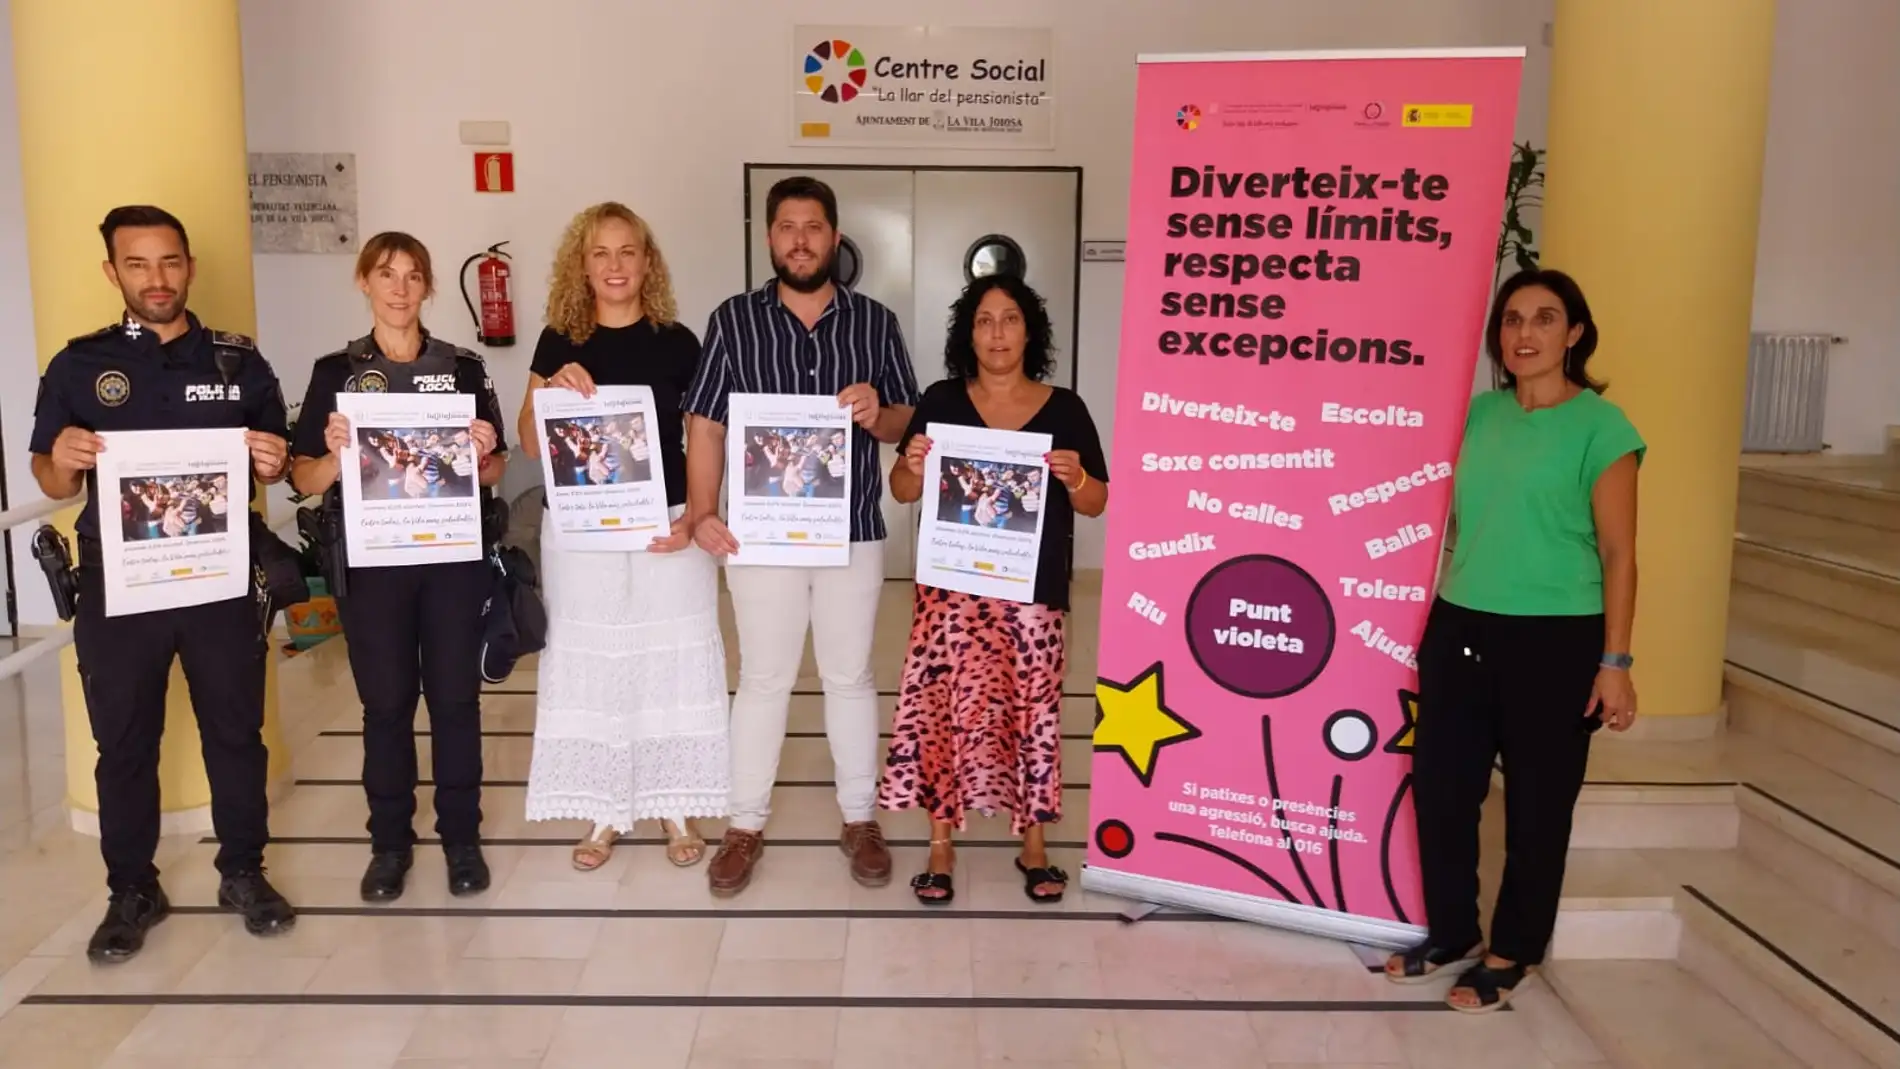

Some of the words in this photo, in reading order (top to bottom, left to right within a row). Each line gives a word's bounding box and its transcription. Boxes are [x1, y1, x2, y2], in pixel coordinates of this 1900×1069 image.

[874, 56, 959, 80] Centre
[970, 59, 1045, 82] Social
[900, 89, 925, 103] llar
[929, 89, 951, 103] del
[956, 91, 1046, 107] pensionista"
[918, 116, 931, 126] DE
[947, 116, 960, 127] LA
[963, 116, 986, 127] VILA
[1169, 165, 1449, 201] Diverteix-te
[1166, 211, 1293, 239] sense
[1305, 205, 1452, 250] límits,
[1164, 249, 1361, 285] respecta
[1160, 291, 1286, 320] sense
[1158, 328, 1425, 366] excepcions.
[419, 382, 456, 392] LOCAL
[1141, 391, 1296, 432] Diverteix-te
[1321, 402, 1424, 427] Escolta
[1141, 452, 1203, 472] Sexe
[1208, 448, 1335, 470] consentit
[1328, 460, 1453, 516] Respecta
[1186, 489, 1223, 514] No
[1228, 501, 1304, 530] calles
[1128, 532, 1217, 560] Gaudix
[1364, 522, 1434, 560] Balla
[1339, 577, 1426, 602] Tolera
[1126, 592, 1168, 626] Riu
[1229, 598, 1293, 624] Punt
[1213, 627, 1304, 654] violeta
[1182, 782, 1197, 796] Si
[1199, 785, 1255, 806] patixes
[1258, 796, 1269, 808] o
[1272, 798, 1357, 823] presències
[1168, 800, 1197, 815] una
[1199, 806, 1268, 829] agressió,
[1270, 815, 1316, 836] busca
[1319, 826, 1368, 844] ajuda.
[1208, 824, 1273, 847] Telefona
[1276, 835, 1292, 850] al
[1294, 838, 1324, 855] 016
